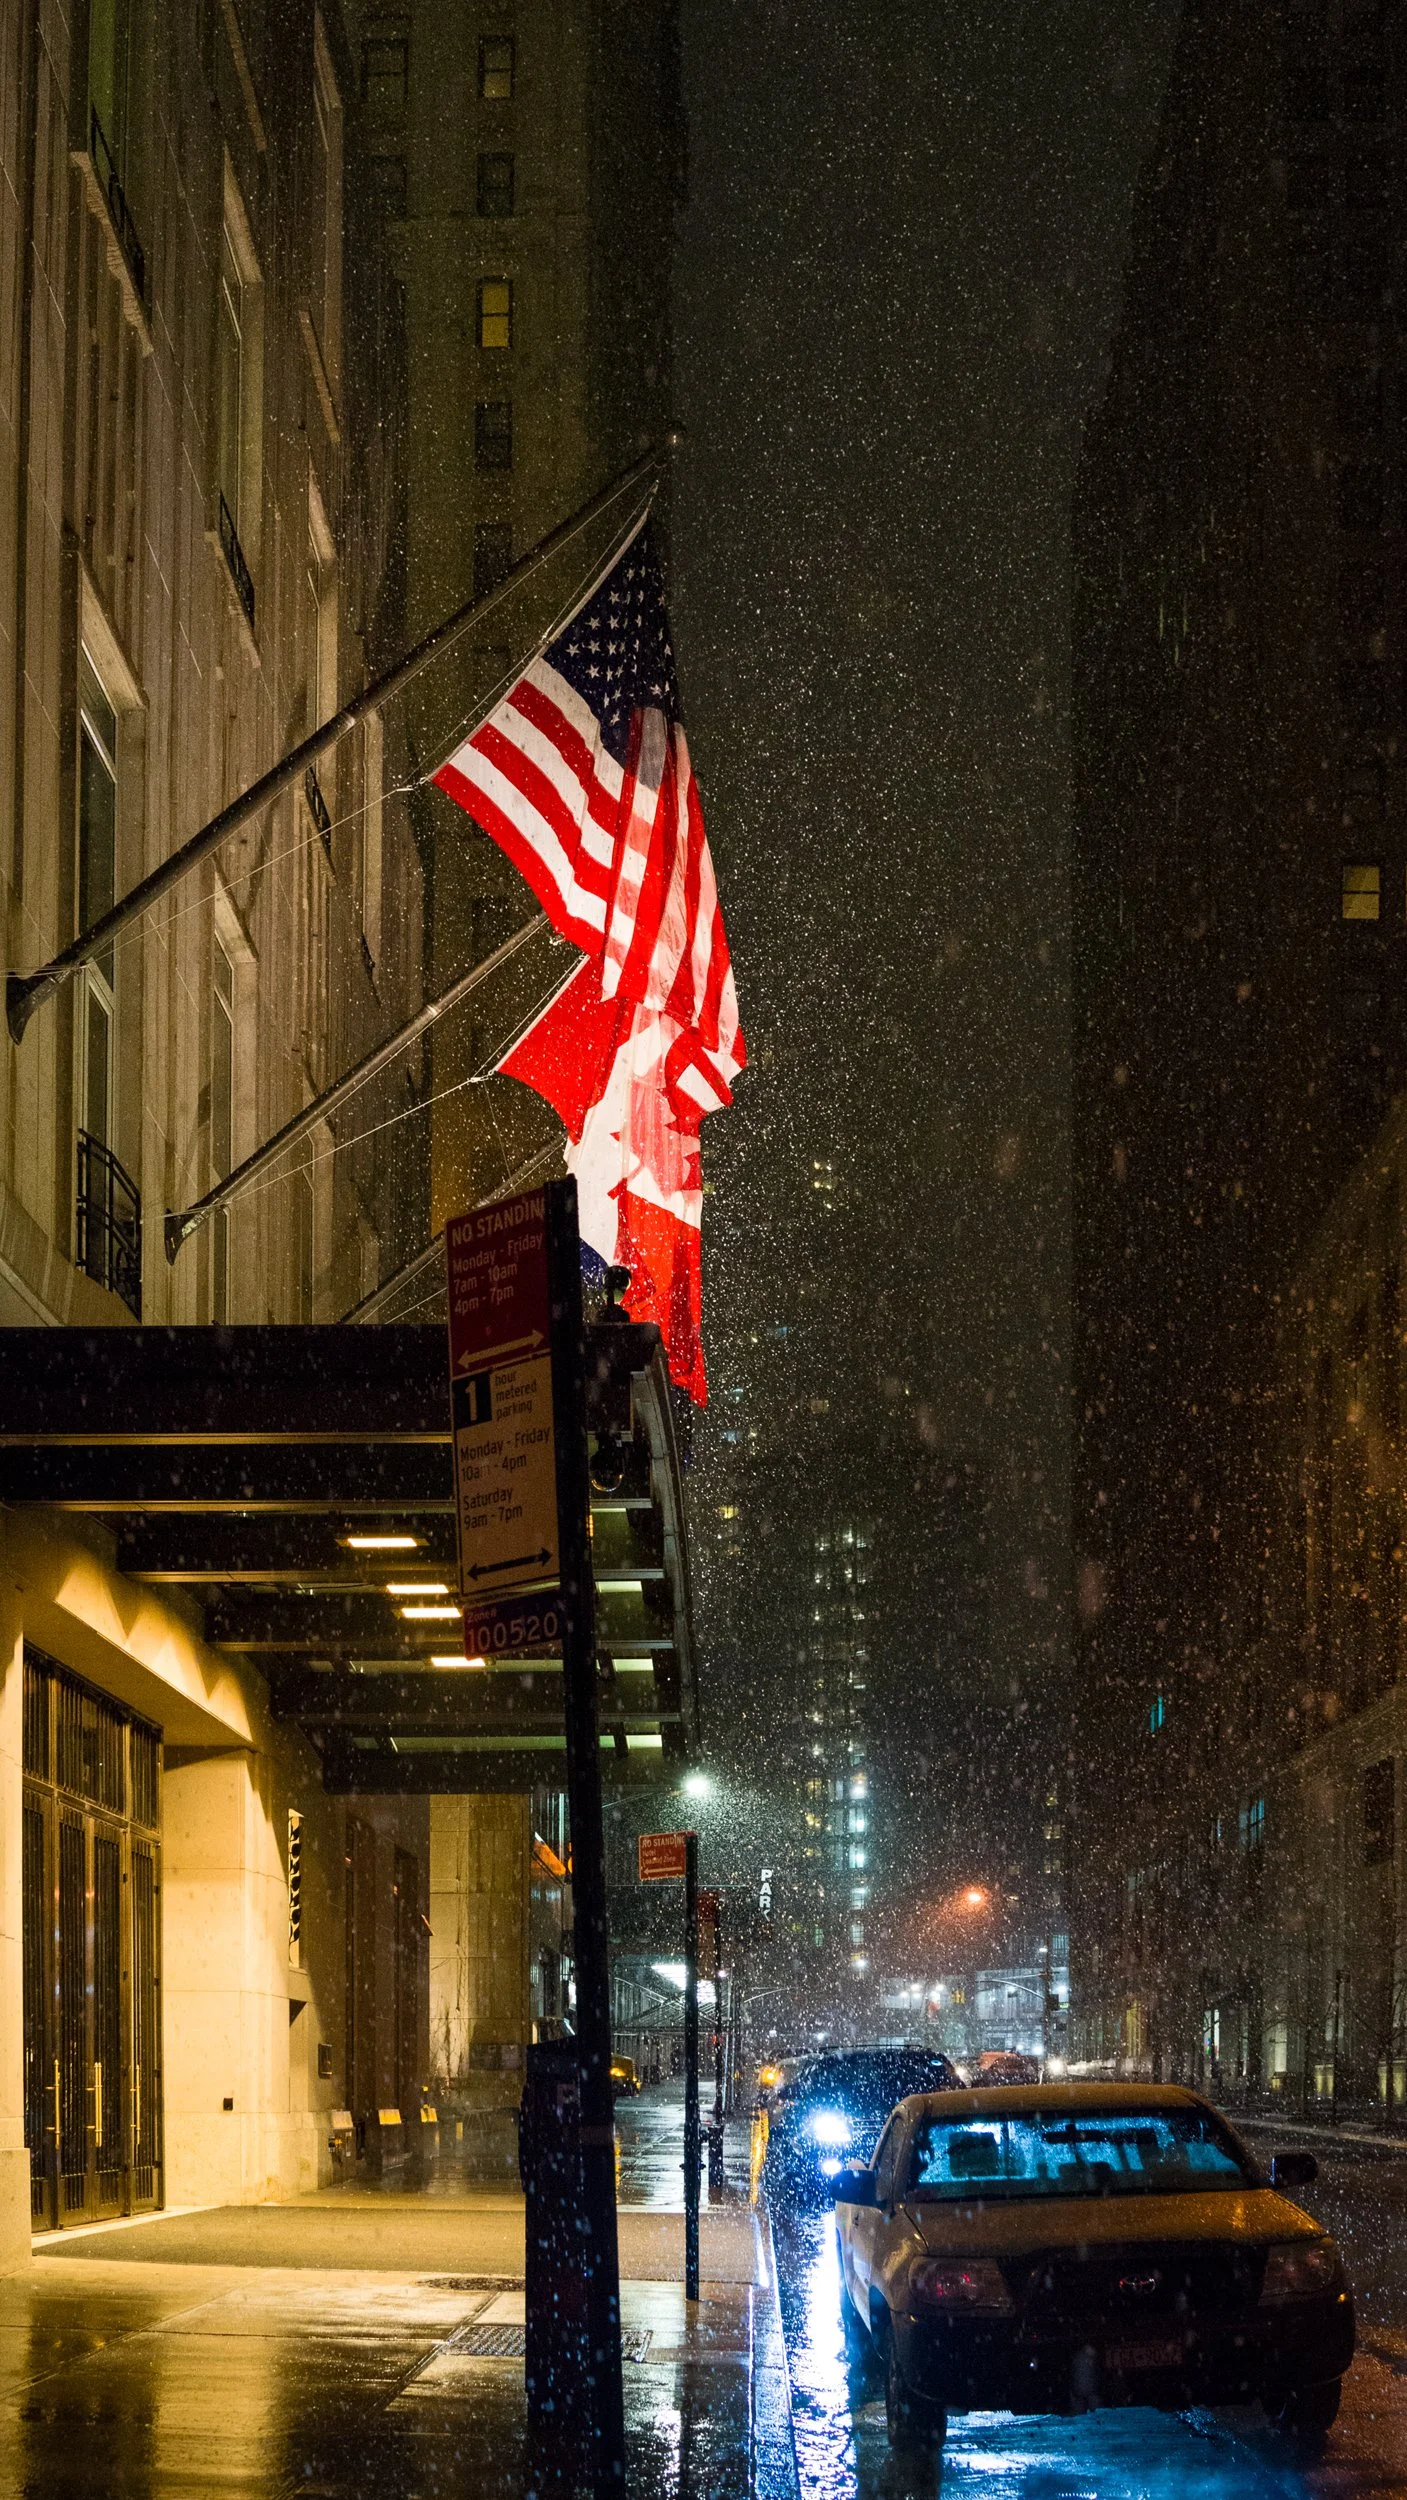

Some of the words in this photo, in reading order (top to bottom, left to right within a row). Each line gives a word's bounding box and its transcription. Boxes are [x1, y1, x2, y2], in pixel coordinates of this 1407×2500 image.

[452, 1222, 473, 1247] NO
[476, 1198, 545, 1238] STANDIN
[453, 1249, 496, 1274] Monday
[507, 1232, 543, 1256] Friday
[454, 1276, 478, 1295] 7am
[488, 1263, 518, 1282] 10am
[454, 1297, 479, 1316] 4pm
[490, 1285, 514, 1306] 7pm
[495, 1370, 517, 1386] hour
[496, 1382, 536, 1402] metered
[464, 1380, 478, 1422] 1
[496, 1400, 532, 1422] parking
[460, 1439, 504, 1463] Monday
[514, 1426, 550, 1448] Friday
[502, 1454, 527, 1473] 4pm
[464, 1487, 514, 1511] Saturday
[464, 1513, 488, 1530] 9am
[498, 1505, 523, 1524] 7pm
[468, 1611, 558, 1652] 100520
[642, 1840, 652, 1848] NO
